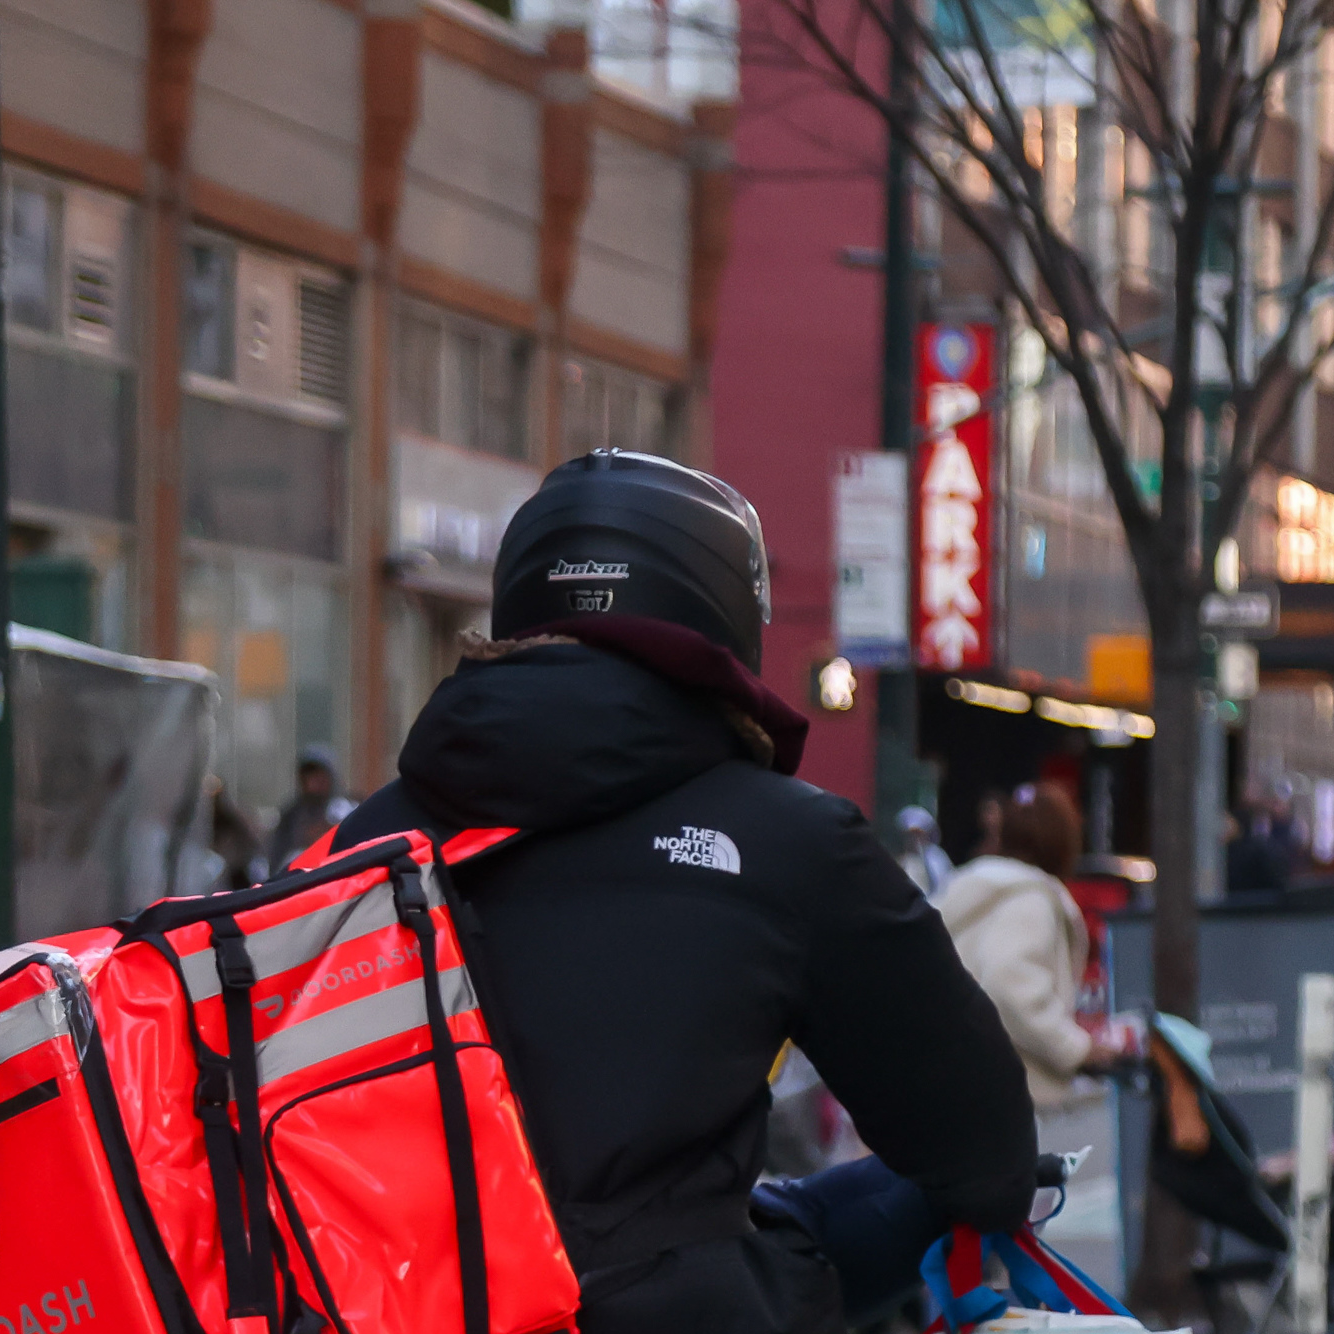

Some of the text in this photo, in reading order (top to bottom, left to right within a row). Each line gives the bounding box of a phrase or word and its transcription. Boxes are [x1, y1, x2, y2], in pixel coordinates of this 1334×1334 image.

[921, 382, 982, 618] PARK
[576, 597, 603, 611] DOT
[682, 826, 715, 841] THE
[654, 836, 714, 854] NORTH
[670, 850, 714, 868] FACE
